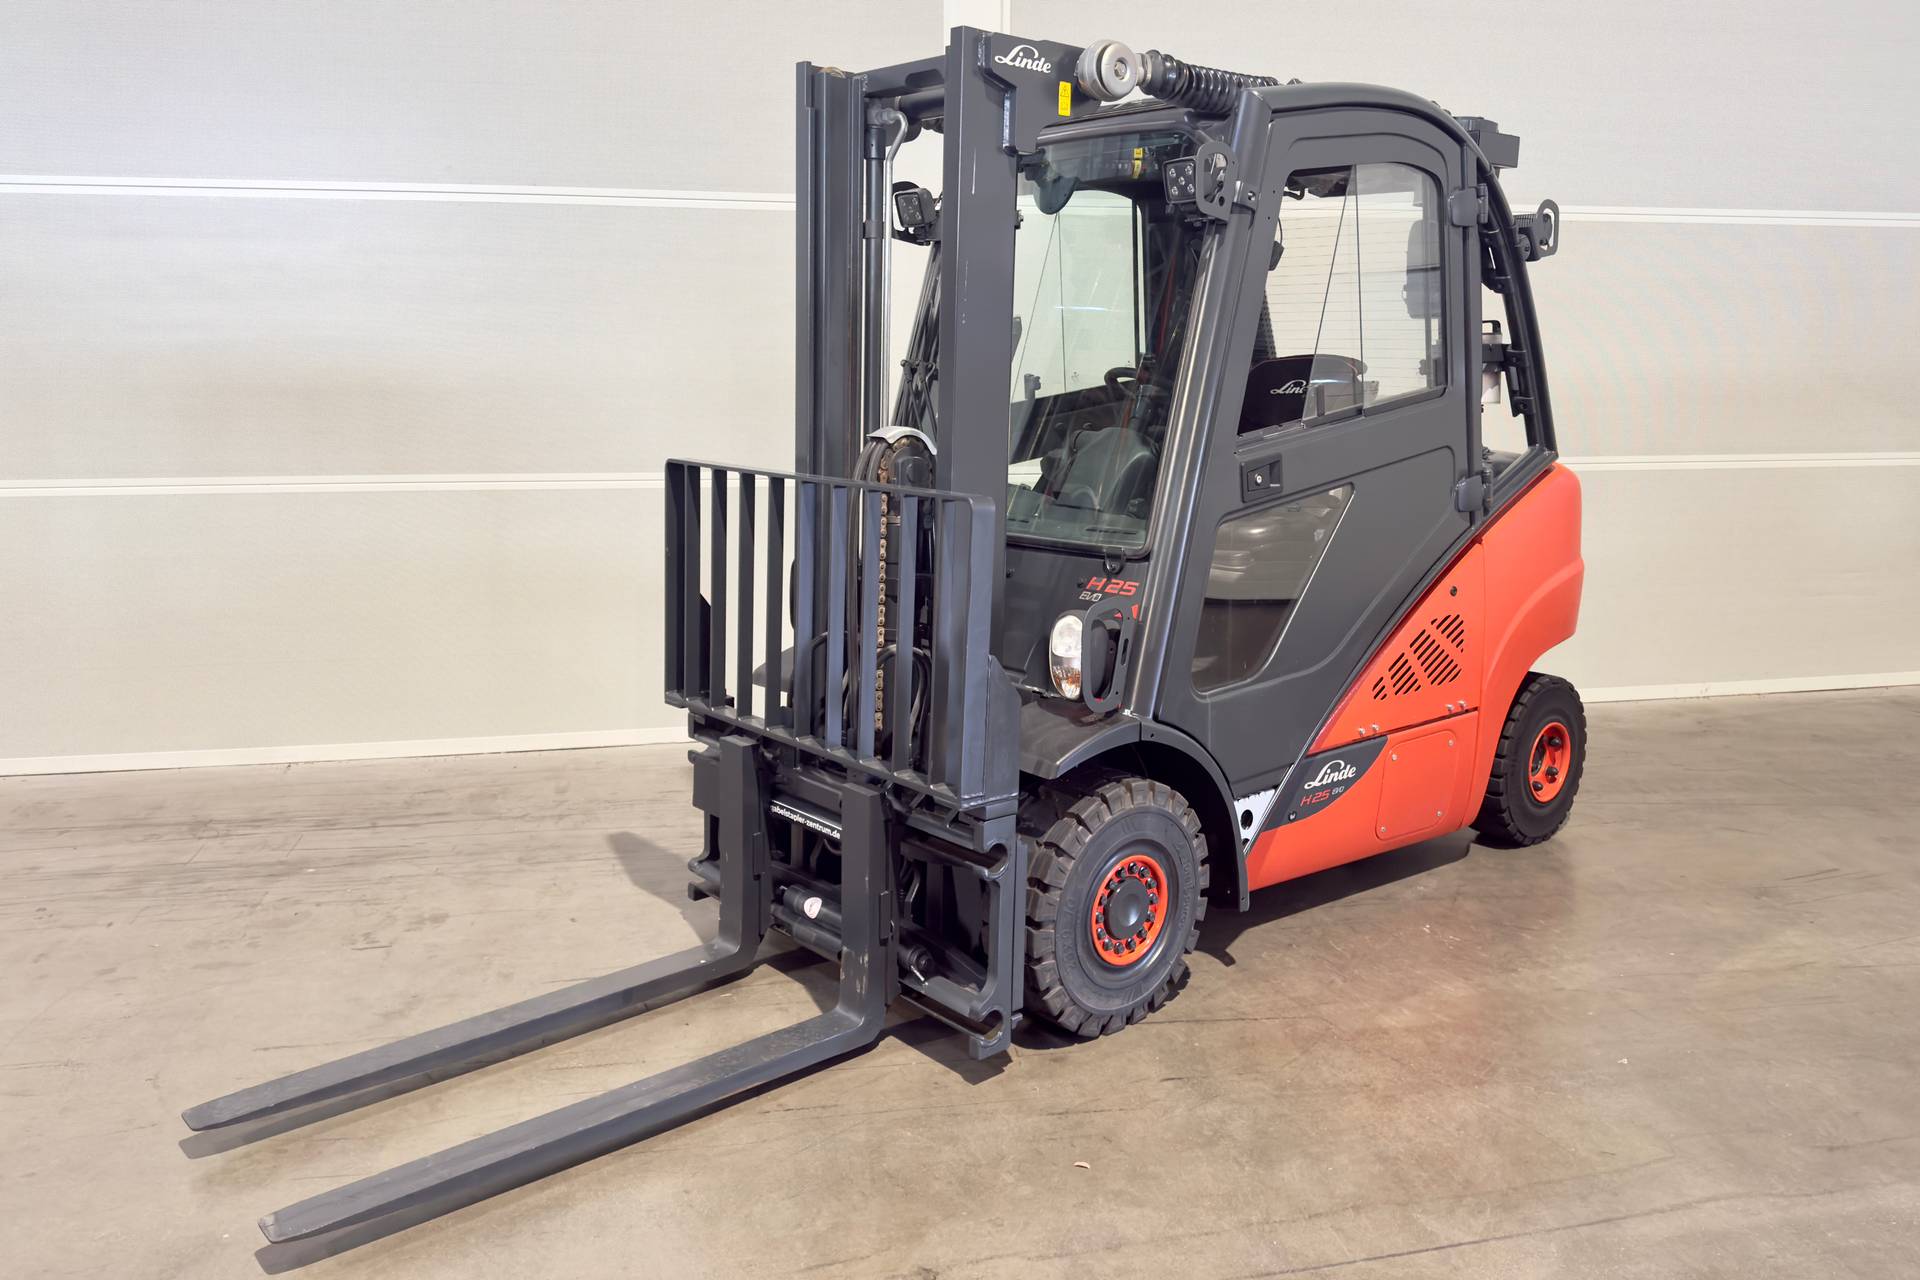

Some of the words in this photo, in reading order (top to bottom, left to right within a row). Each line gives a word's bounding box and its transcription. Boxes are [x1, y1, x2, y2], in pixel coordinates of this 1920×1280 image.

[994, 44, 1052, 73] Linde
[1270, 379, 1307, 395] Lin
[1304, 759, 1357, 789] Linde
